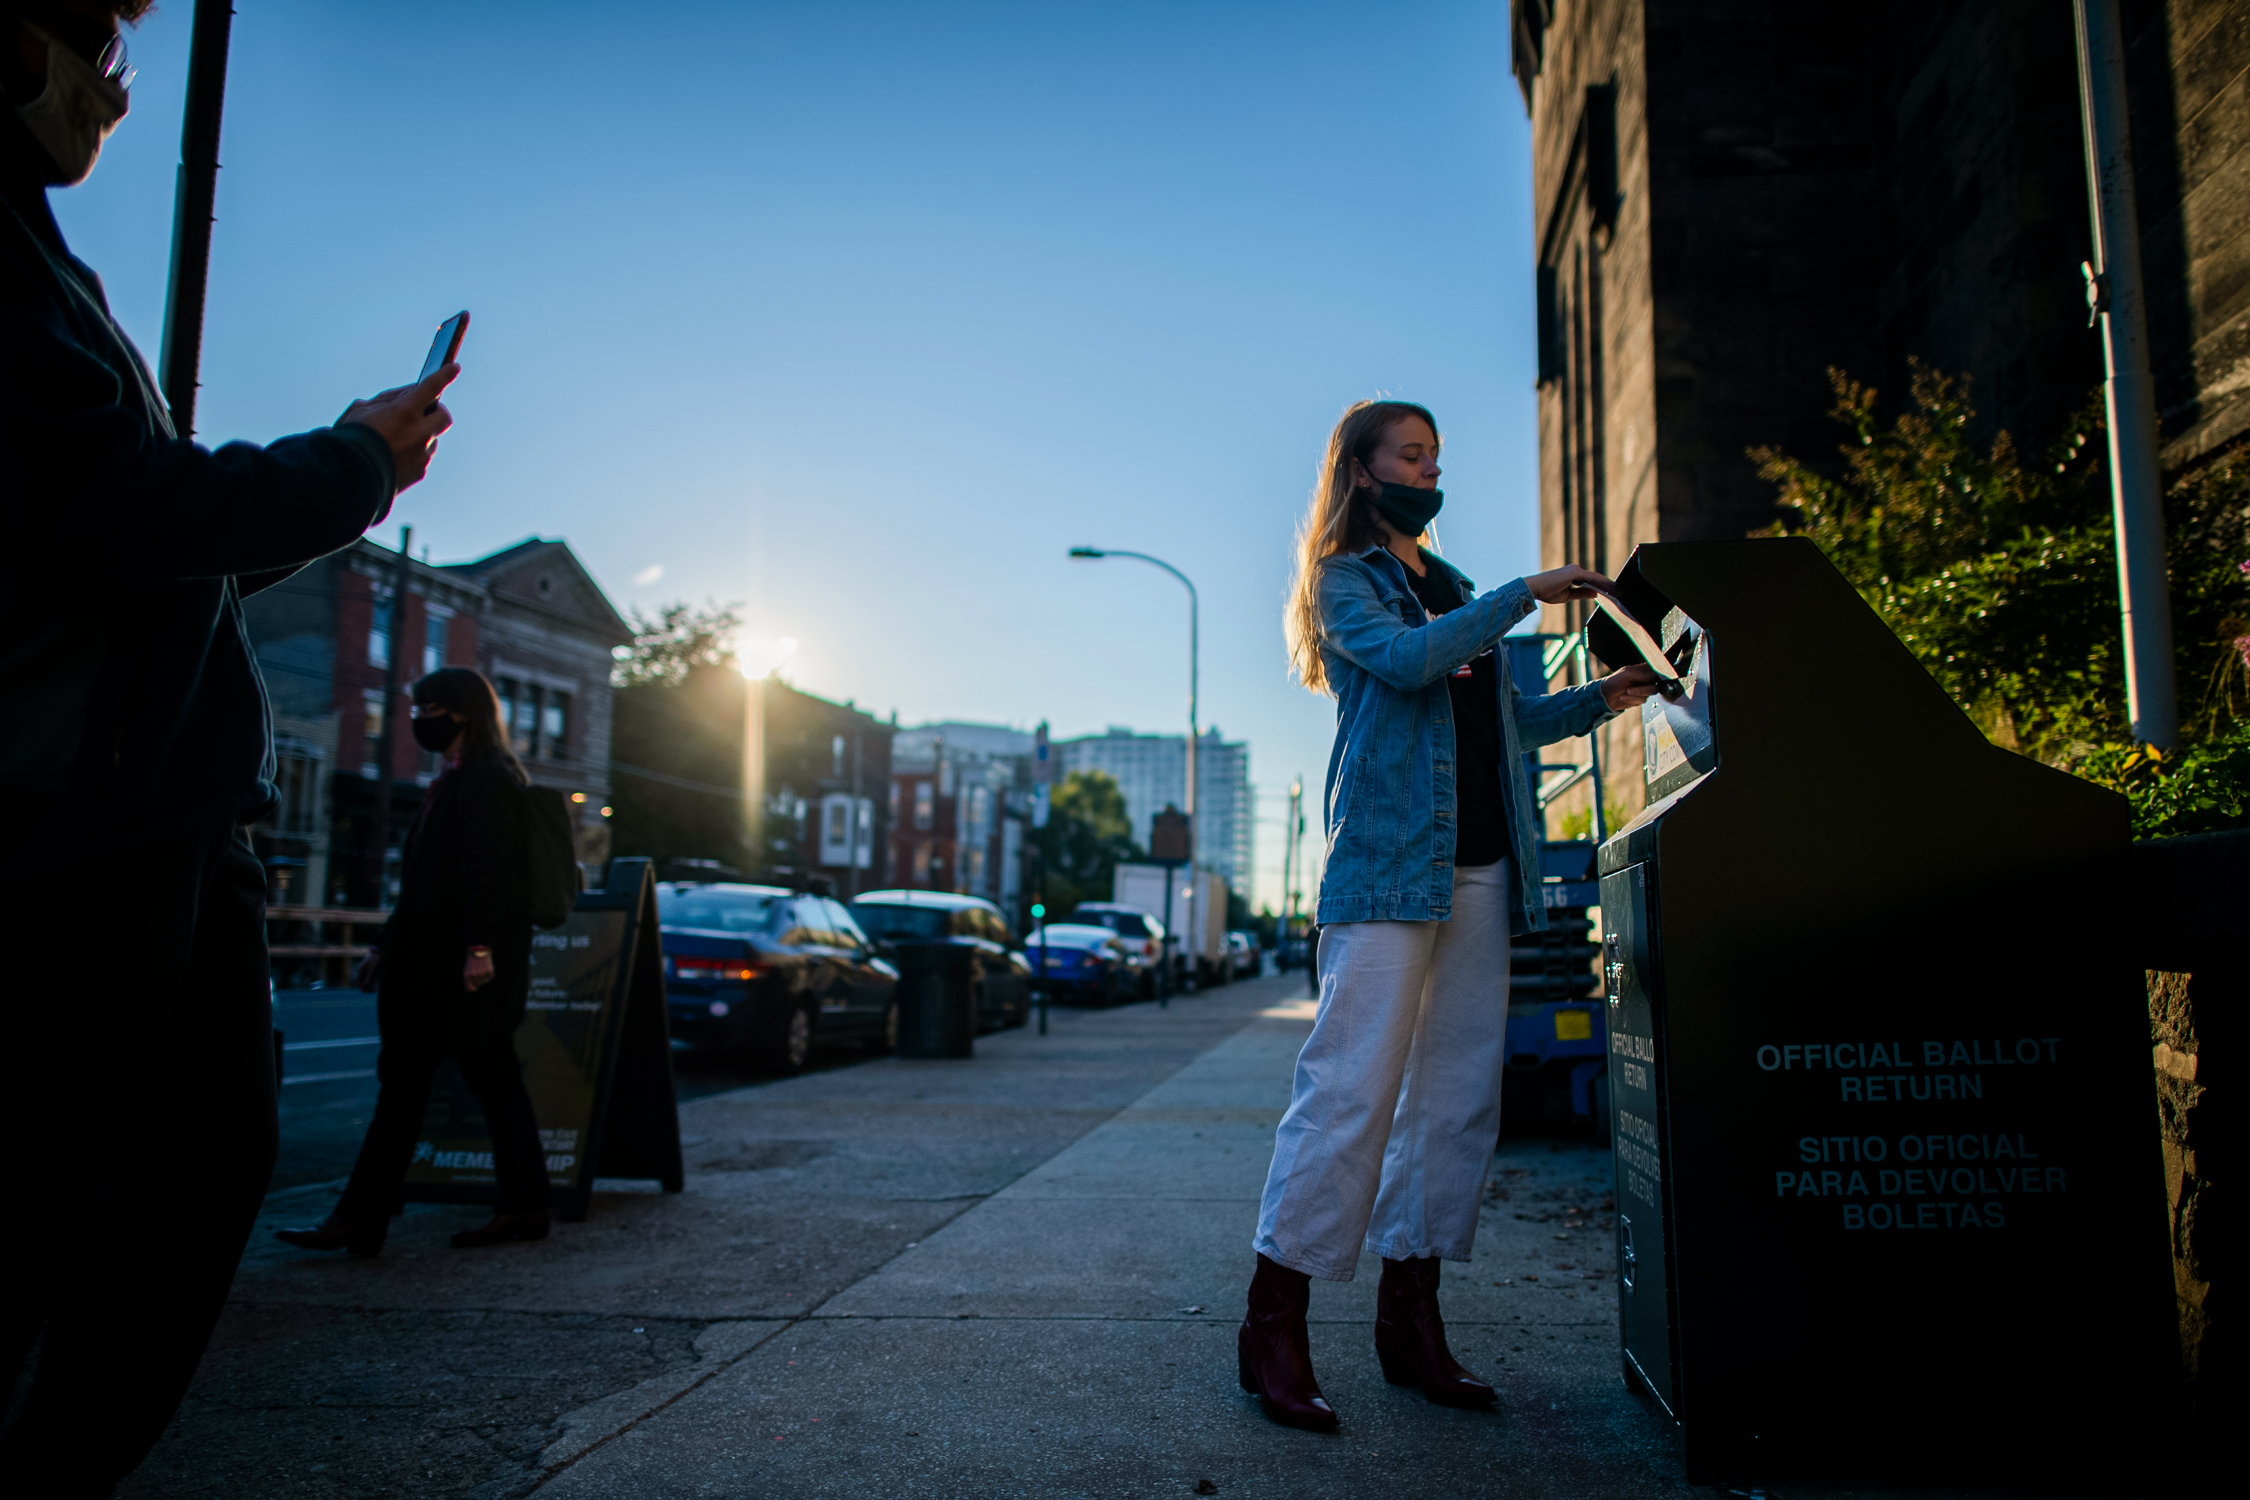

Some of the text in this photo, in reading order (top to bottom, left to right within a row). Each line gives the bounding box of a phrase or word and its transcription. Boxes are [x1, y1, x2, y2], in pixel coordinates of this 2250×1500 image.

[1612, 1031, 1655, 1063] OFFICIAL BALLO
[1756, 1037, 2062, 1071] OFFICIAL BALLOT
[1624, 1062, 1647, 1091] RETURN
[1840, 1073, 1983, 1102] RETURN
[1620, 1109, 1657, 1150] SITIO OFICIAL
[1617, 1135, 1633, 1164] PARA
[1799, 1133, 2038, 1163] SITIO OFICIAL
[1628, 1168, 1655, 1208] BOLETAS
[1775, 1166, 2067, 1197] PARA DEVOLVER
[1842, 1201, 2006, 1231] BOLETAS
